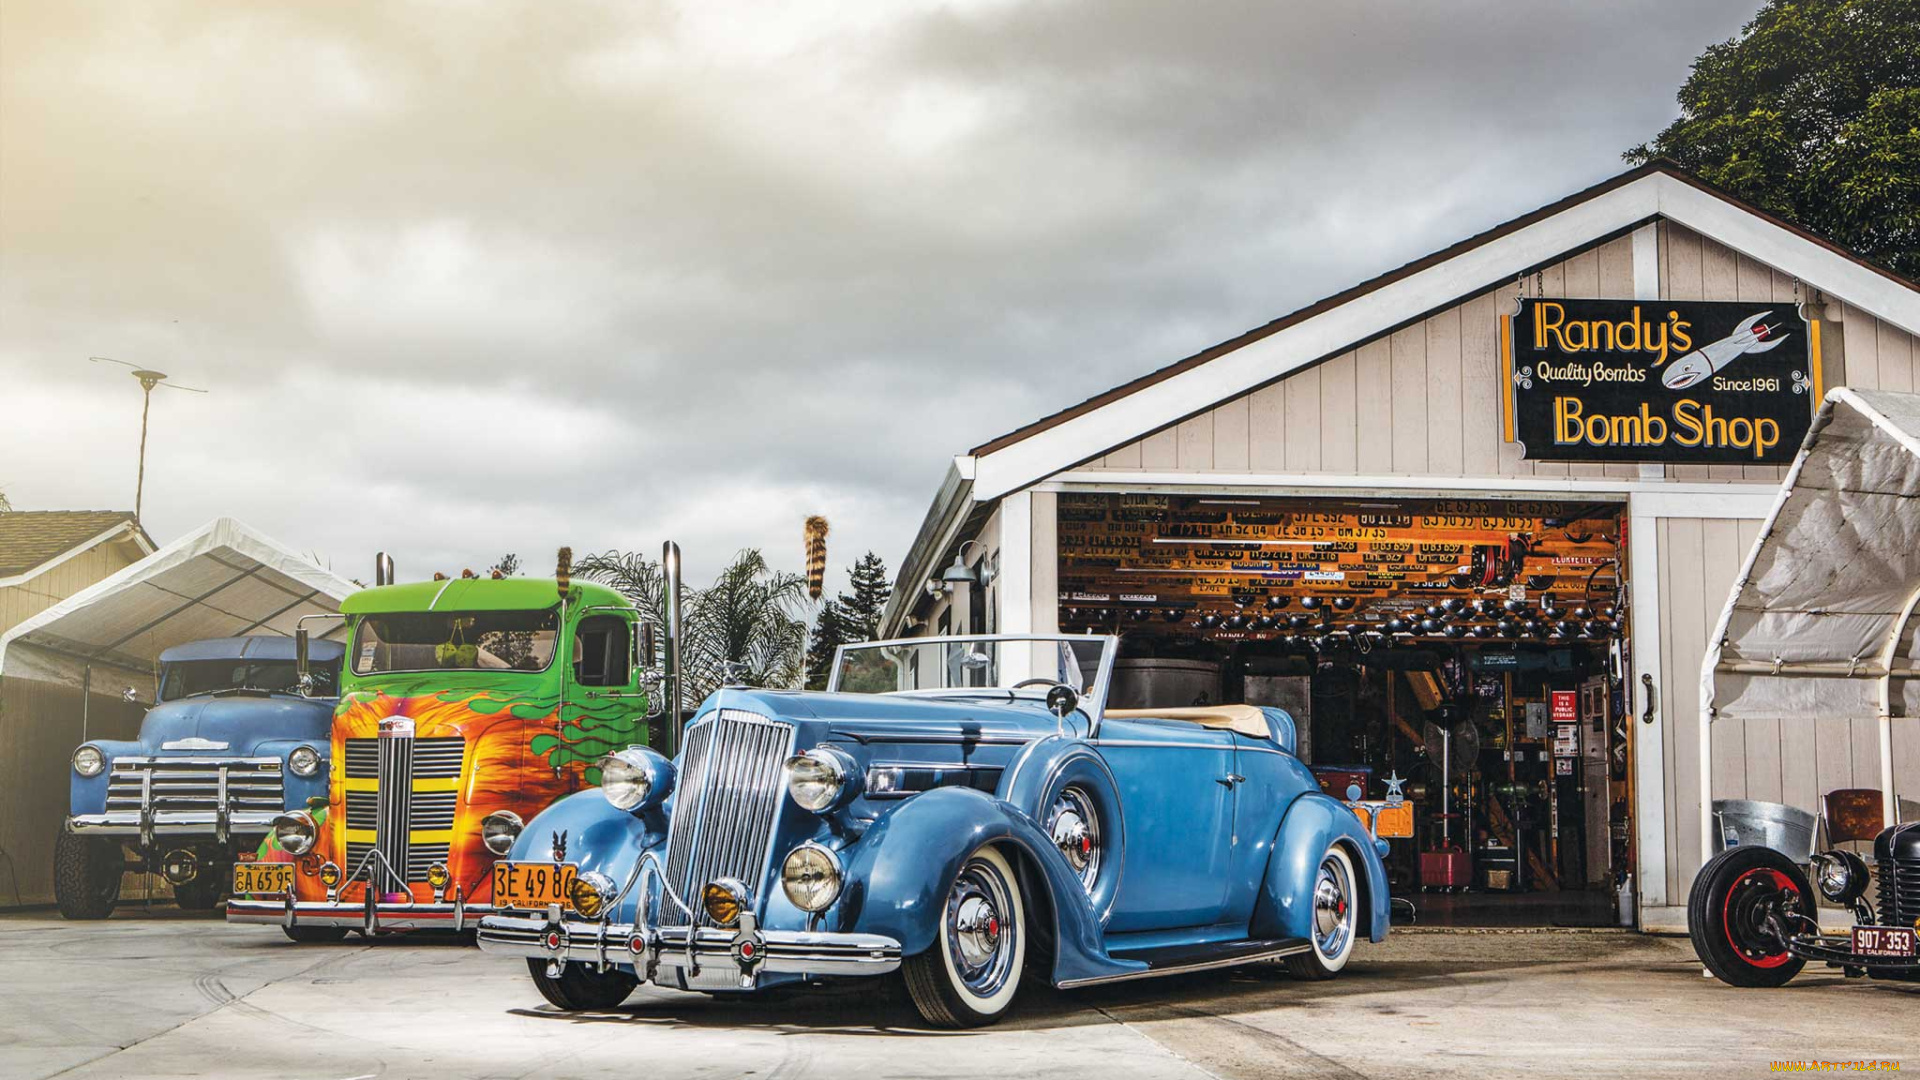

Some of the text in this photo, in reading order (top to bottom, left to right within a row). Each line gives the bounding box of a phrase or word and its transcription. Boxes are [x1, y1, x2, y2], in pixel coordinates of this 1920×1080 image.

[1533, 302, 1692, 367] Randy's
[1537, 361, 1647, 387] Quality Bombs
[1713, 376, 1780, 392] Since 1961
[1553, 397, 1780, 458] Bomb Shop
[496, 867, 520, 897] 3E
[526, 868, 546, 898] 49
[512, 899, 557, 908] CALIFORN
